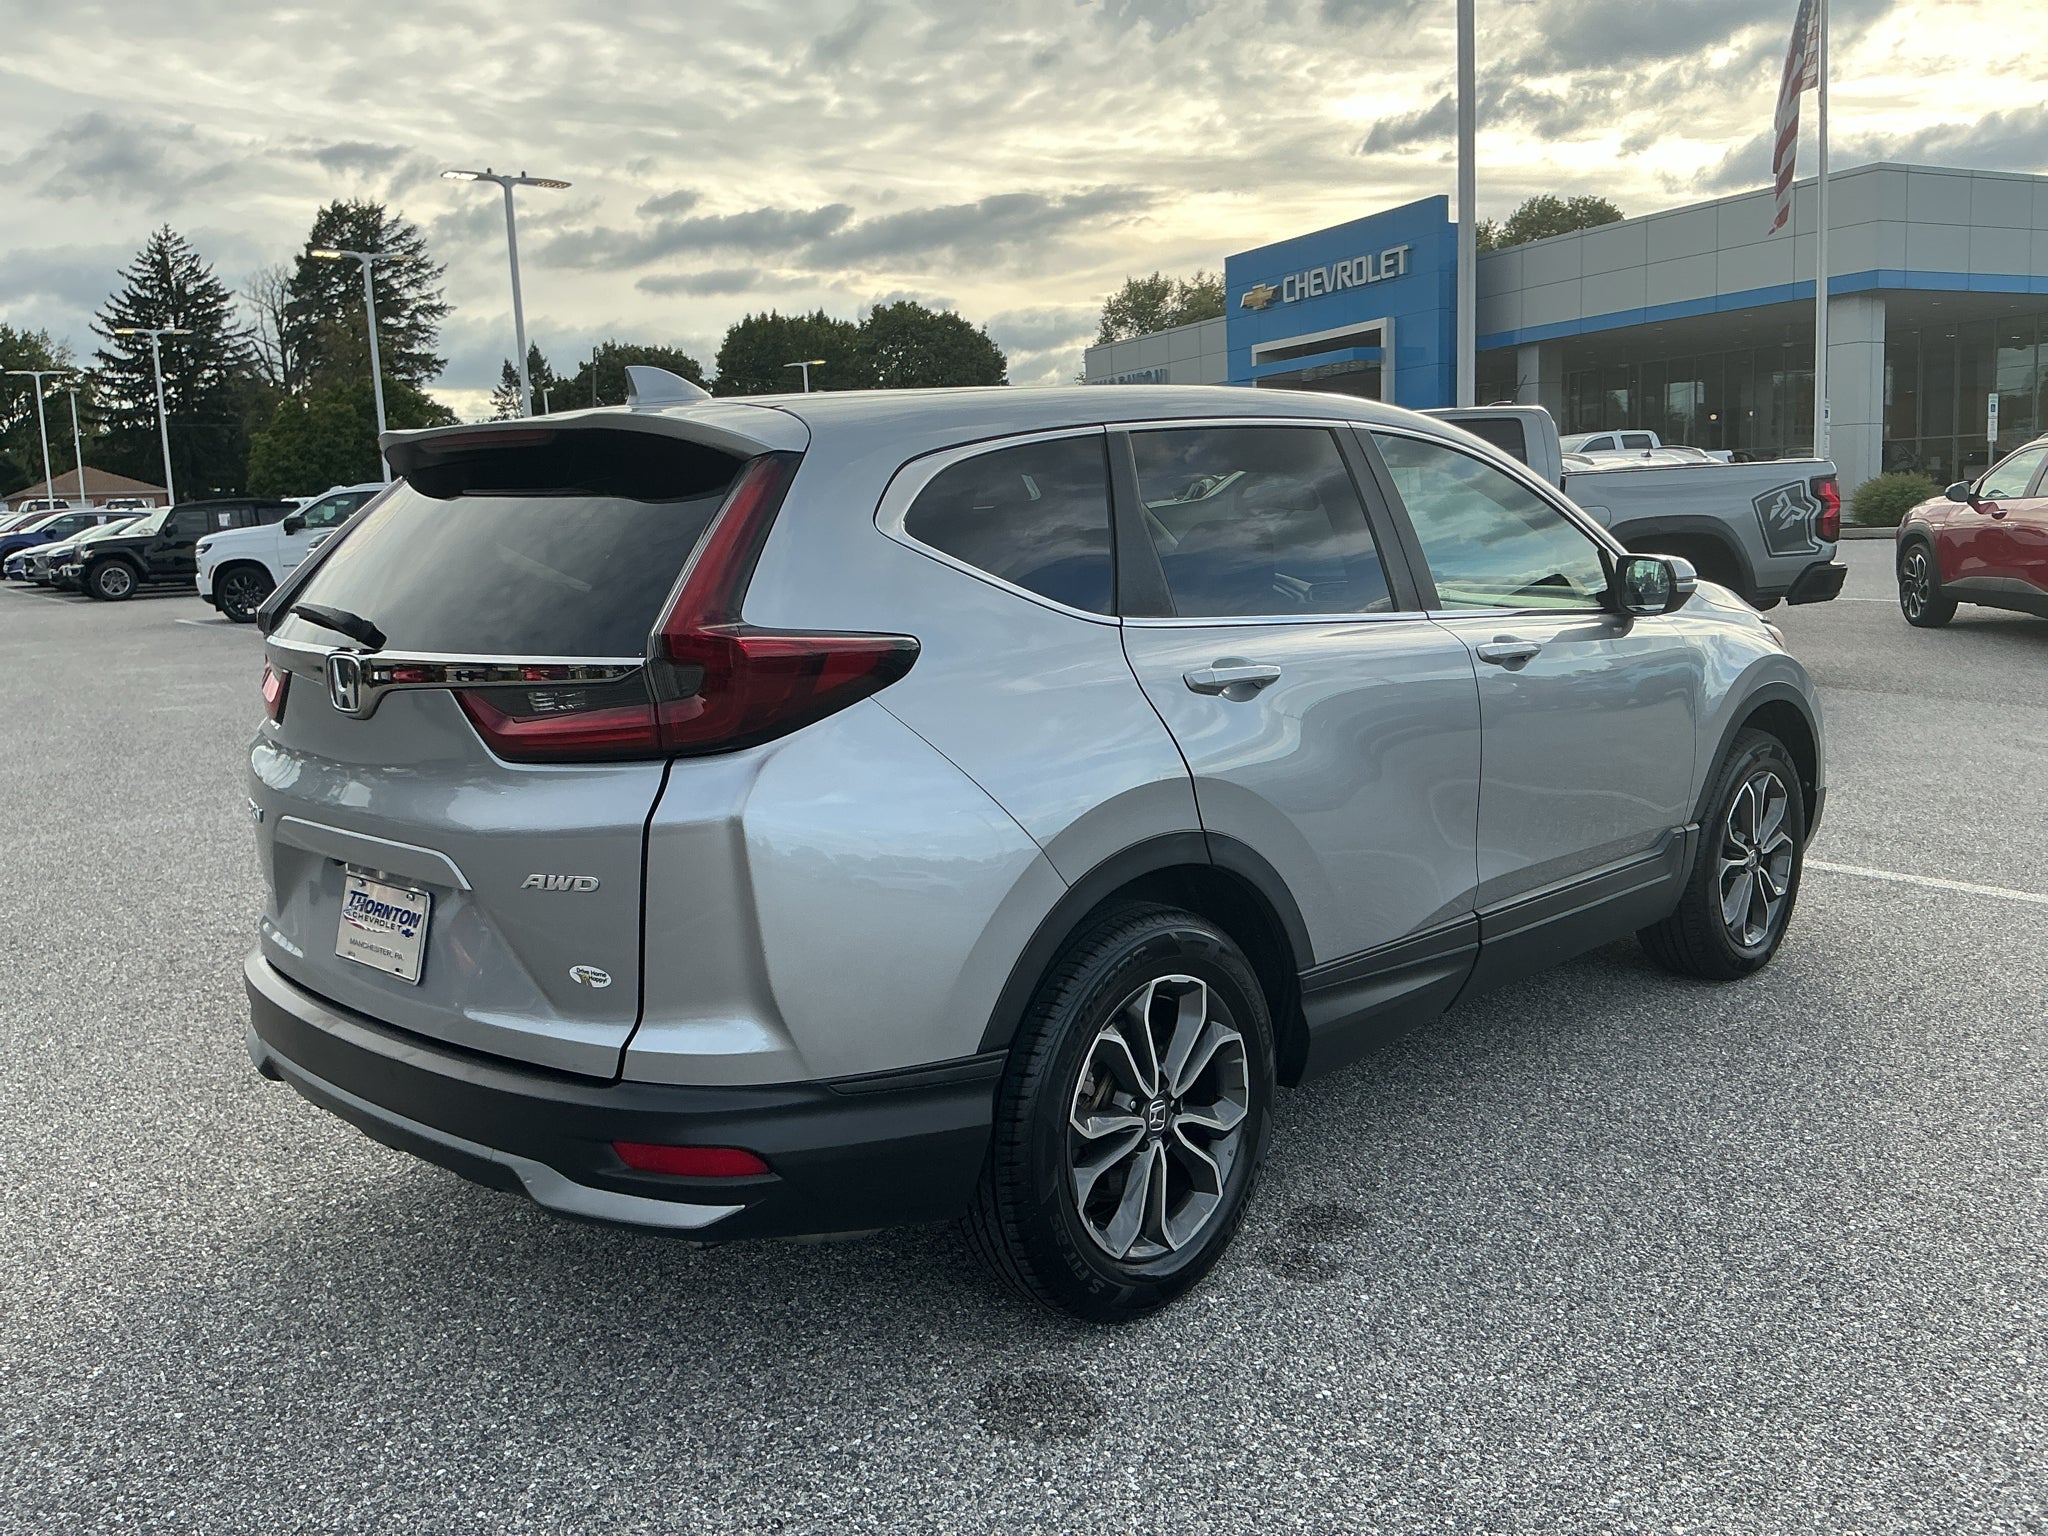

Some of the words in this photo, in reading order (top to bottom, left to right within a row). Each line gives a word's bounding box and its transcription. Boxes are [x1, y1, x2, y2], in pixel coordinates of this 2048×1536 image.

[1282, 244, 1409, 304] CHEVROLET
[520, 873, 599, 892] AWD
[349, 890, 422, 929] THORNTON
[352, 911, 402, 932] CHEVROLET
[590, 970, 607, 978] Home
